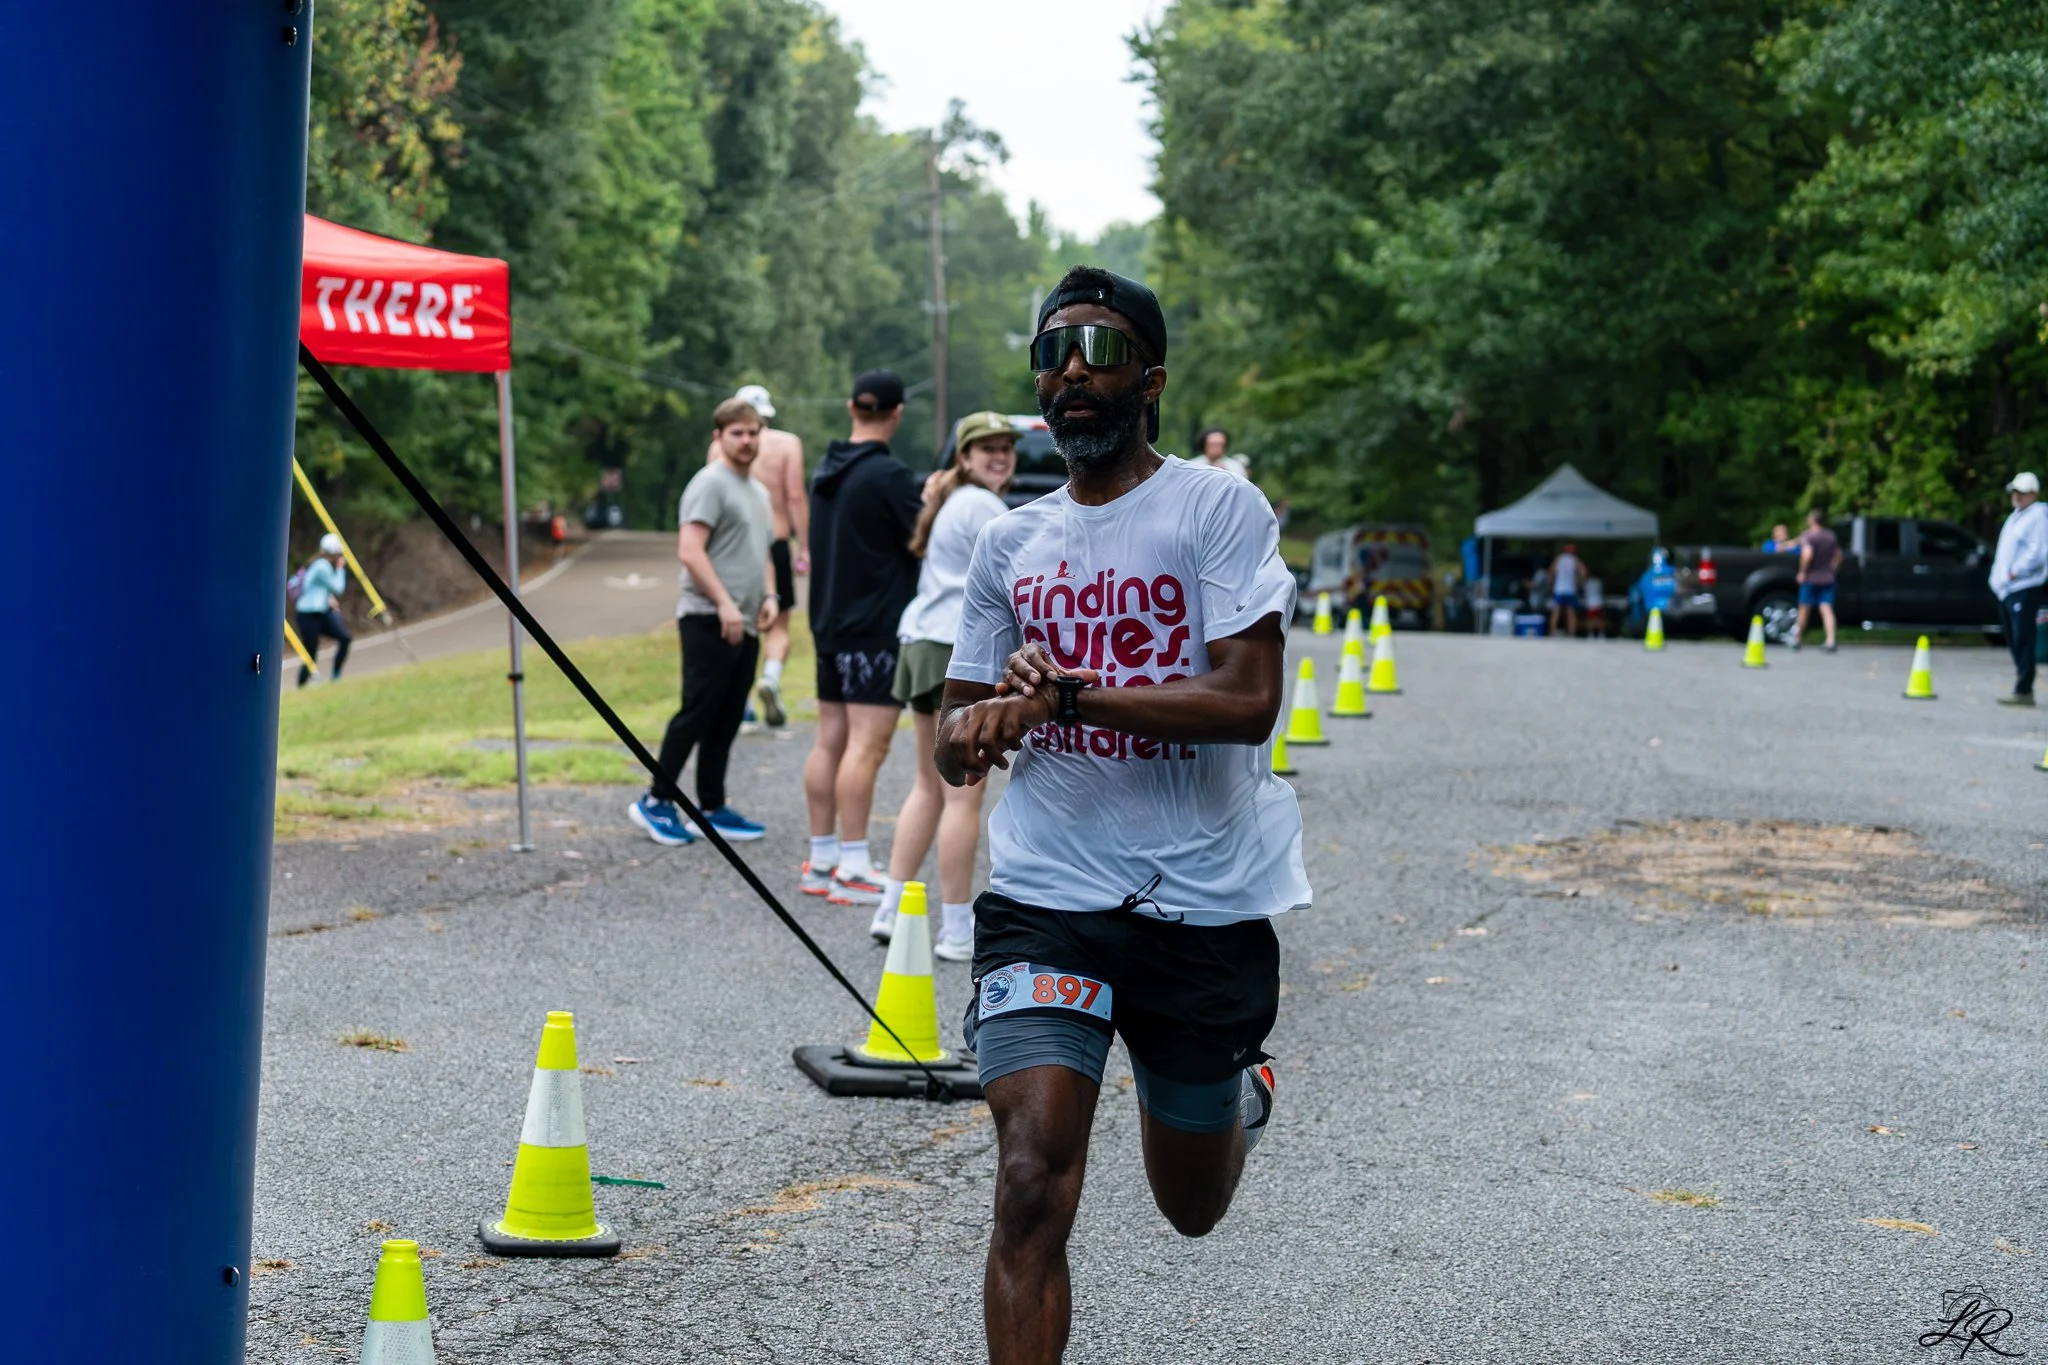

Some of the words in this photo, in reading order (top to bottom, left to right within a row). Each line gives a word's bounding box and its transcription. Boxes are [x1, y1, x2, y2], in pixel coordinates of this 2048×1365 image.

[316, 276, 475, 340] THERE
[1013, 567, 1187, 626] Finding
[1032, 973, 1103, 1011] 897
